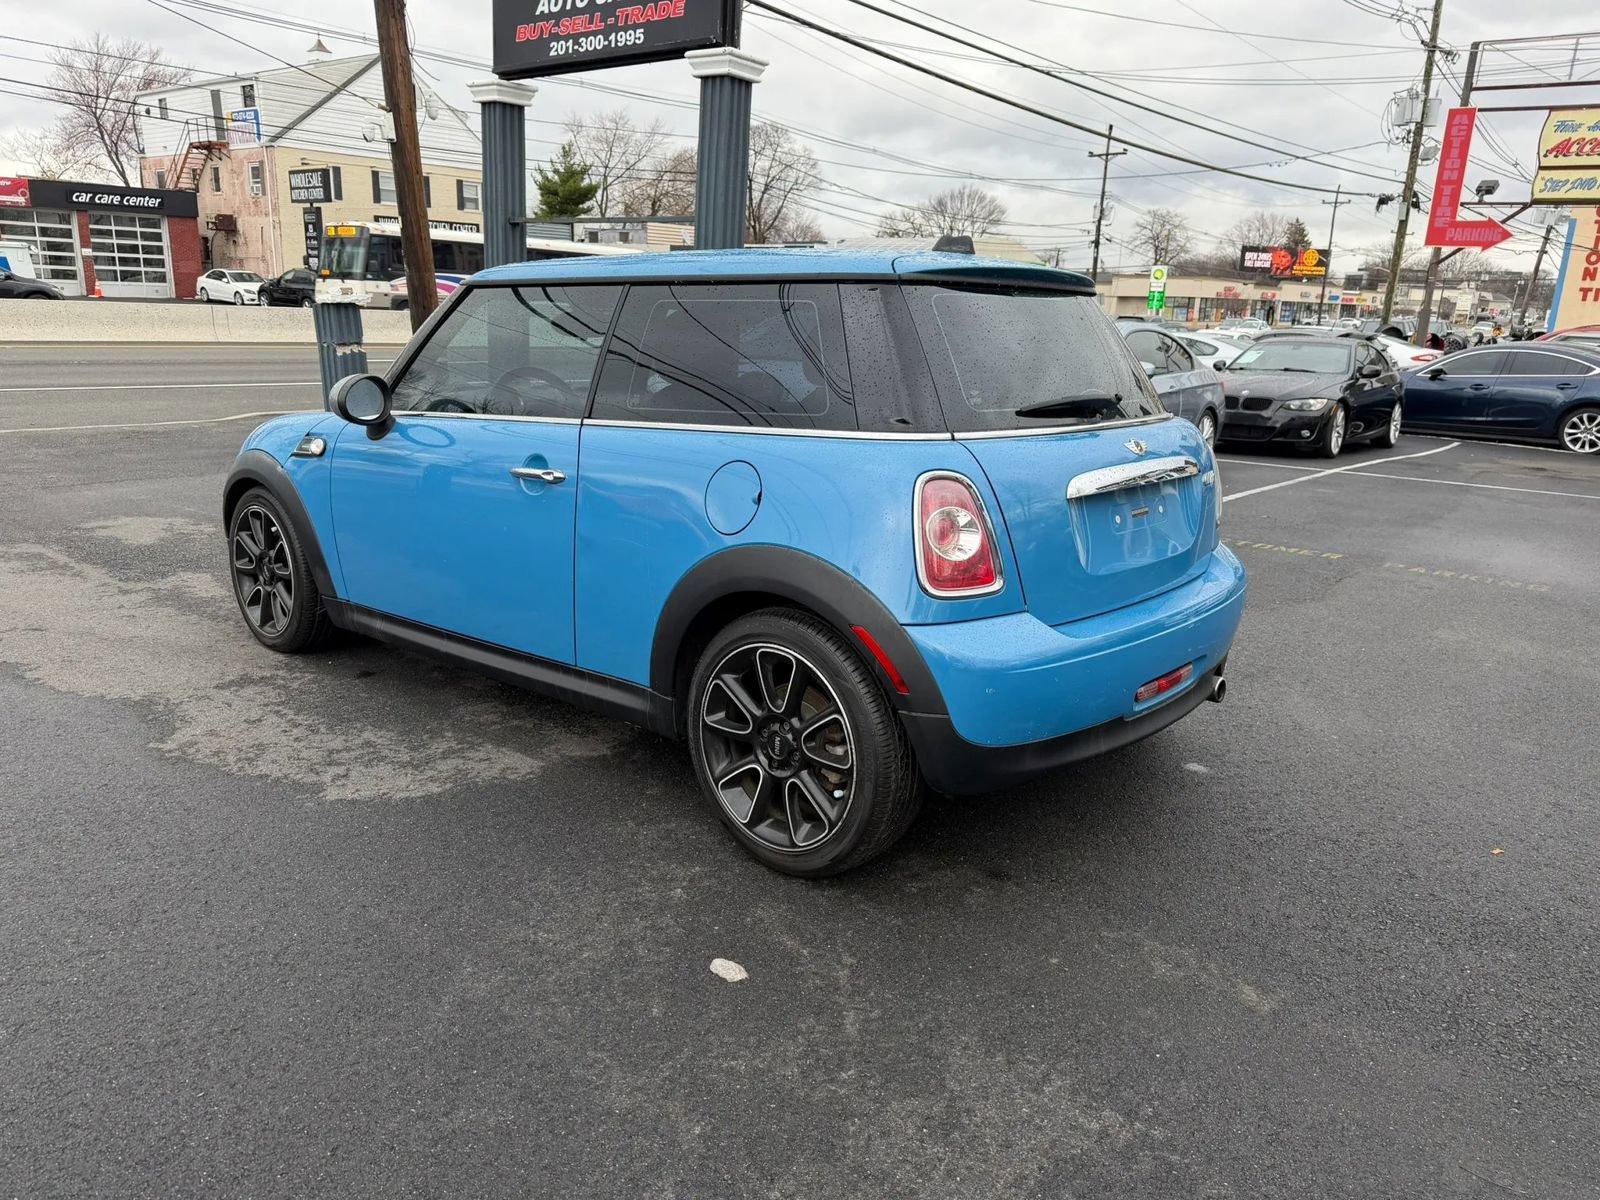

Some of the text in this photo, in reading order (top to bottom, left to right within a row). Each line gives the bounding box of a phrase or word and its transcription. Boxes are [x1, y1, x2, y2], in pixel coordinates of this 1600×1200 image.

[616, 0, 686, 26] TRADE
[549, 28, 645, 56] 201-300-1995
[290, 171, 323, 188] WHOLESALE
[1434, 114, 1469, 227] ACTION TIRE
[72, 192, 162, 208] car care center
[1444, 227, 1503, 241] PARKING
